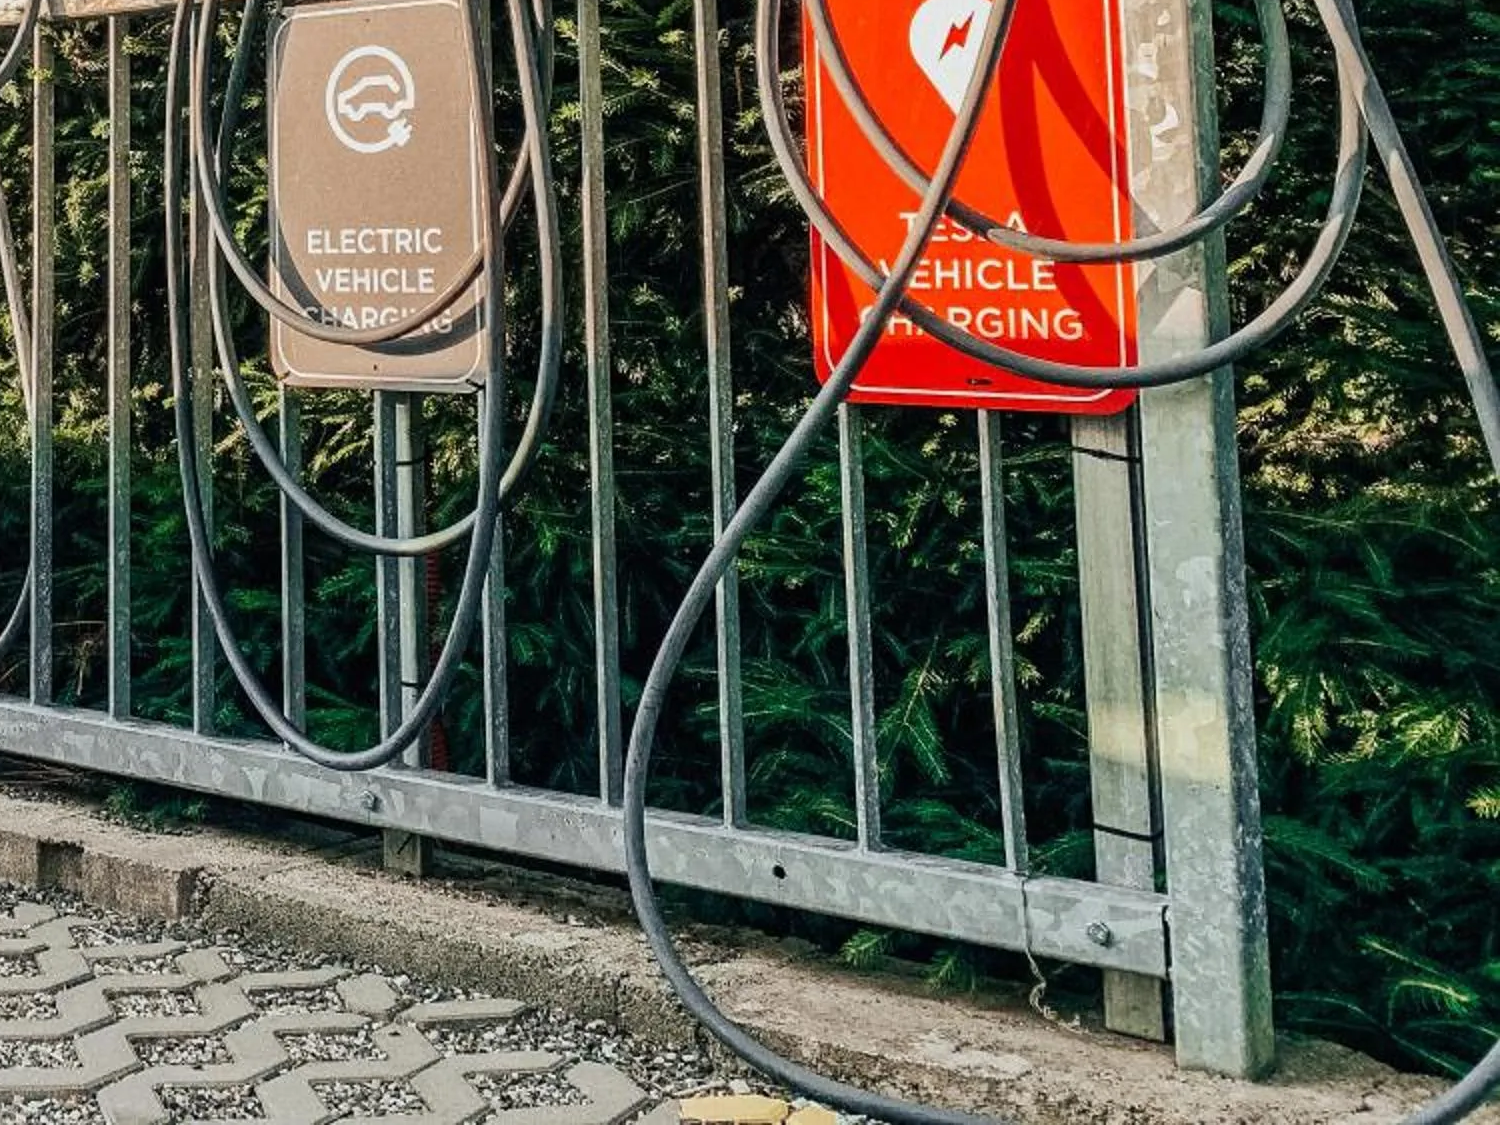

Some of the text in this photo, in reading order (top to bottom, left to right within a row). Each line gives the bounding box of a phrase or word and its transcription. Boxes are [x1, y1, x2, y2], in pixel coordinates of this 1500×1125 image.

[307, 228, 443, 254] ELECTRIC
[898, 211, 1029, 242] TESA
[315, 268, 436, 293] VEHICLE
[878, 258, 1057, 291] EHICLE
[304, 306, 453, 334] HARGG
[859, 306, 1084, 340] HRGING
